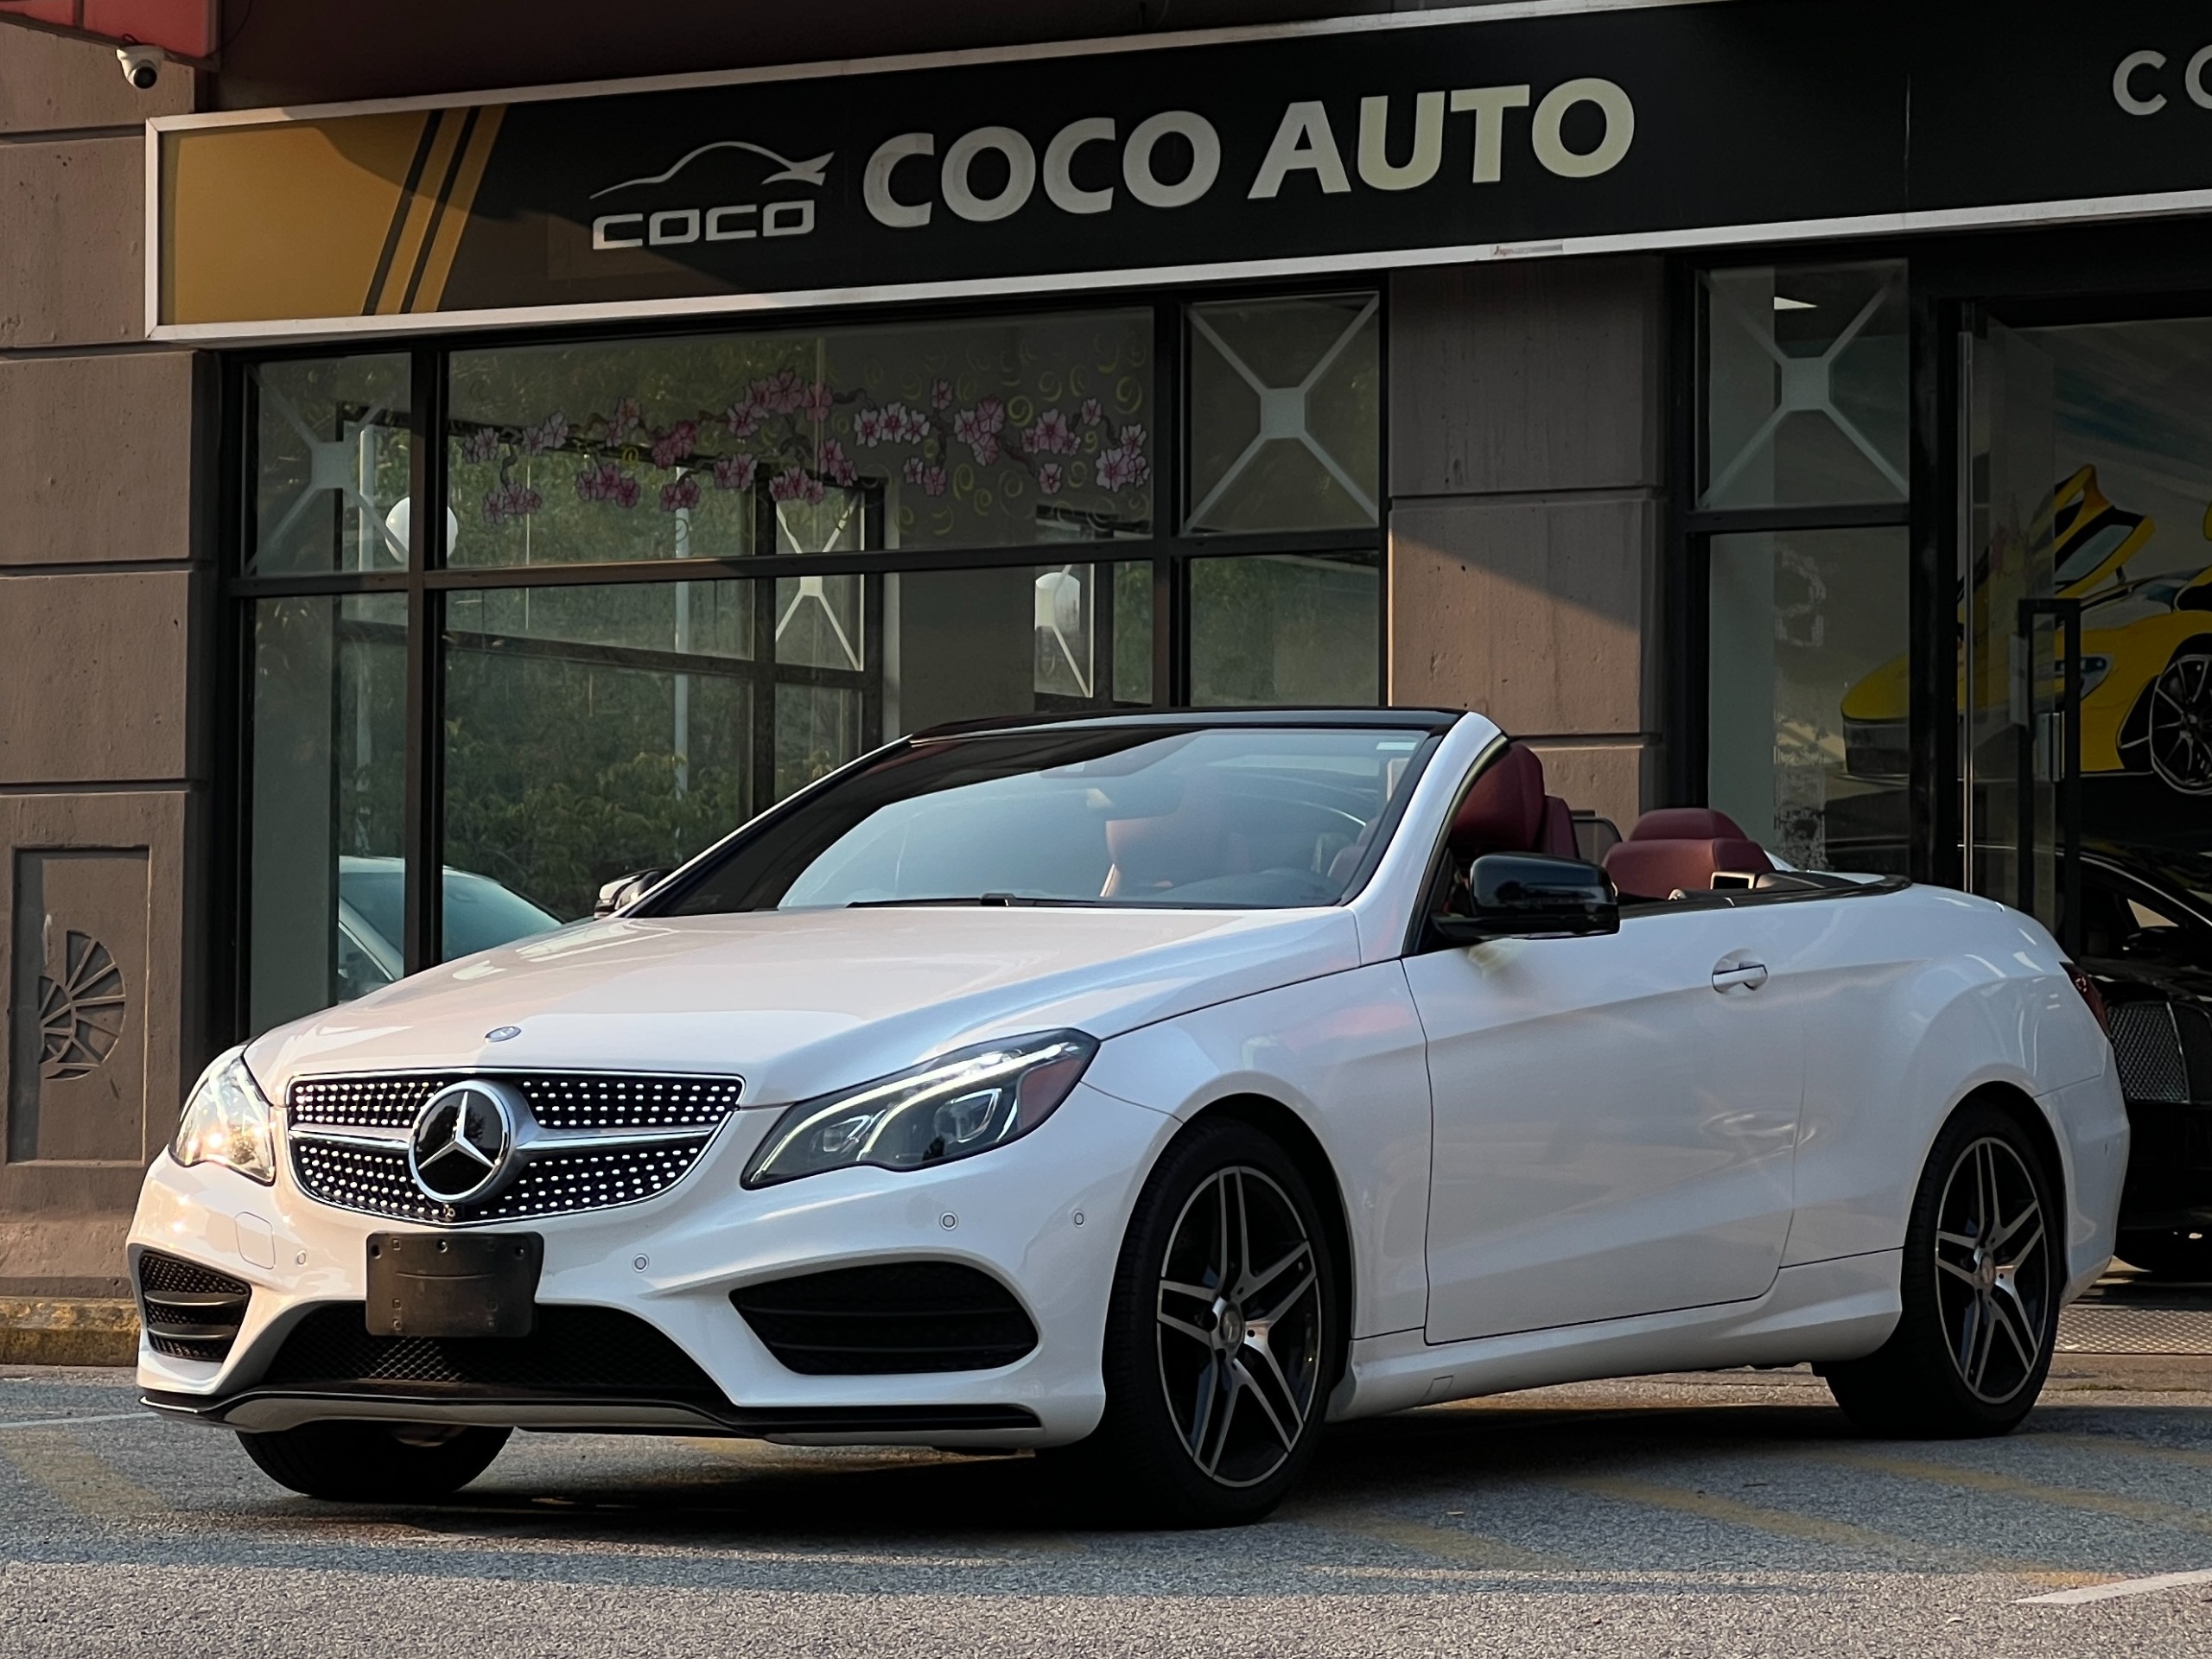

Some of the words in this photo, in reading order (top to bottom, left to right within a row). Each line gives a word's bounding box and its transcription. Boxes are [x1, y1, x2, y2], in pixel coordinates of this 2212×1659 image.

[863, 111, 1220, 227] COCO
[1247, 77, 1635, 199] AUTO
[592, 200, 815, 250] COCO
